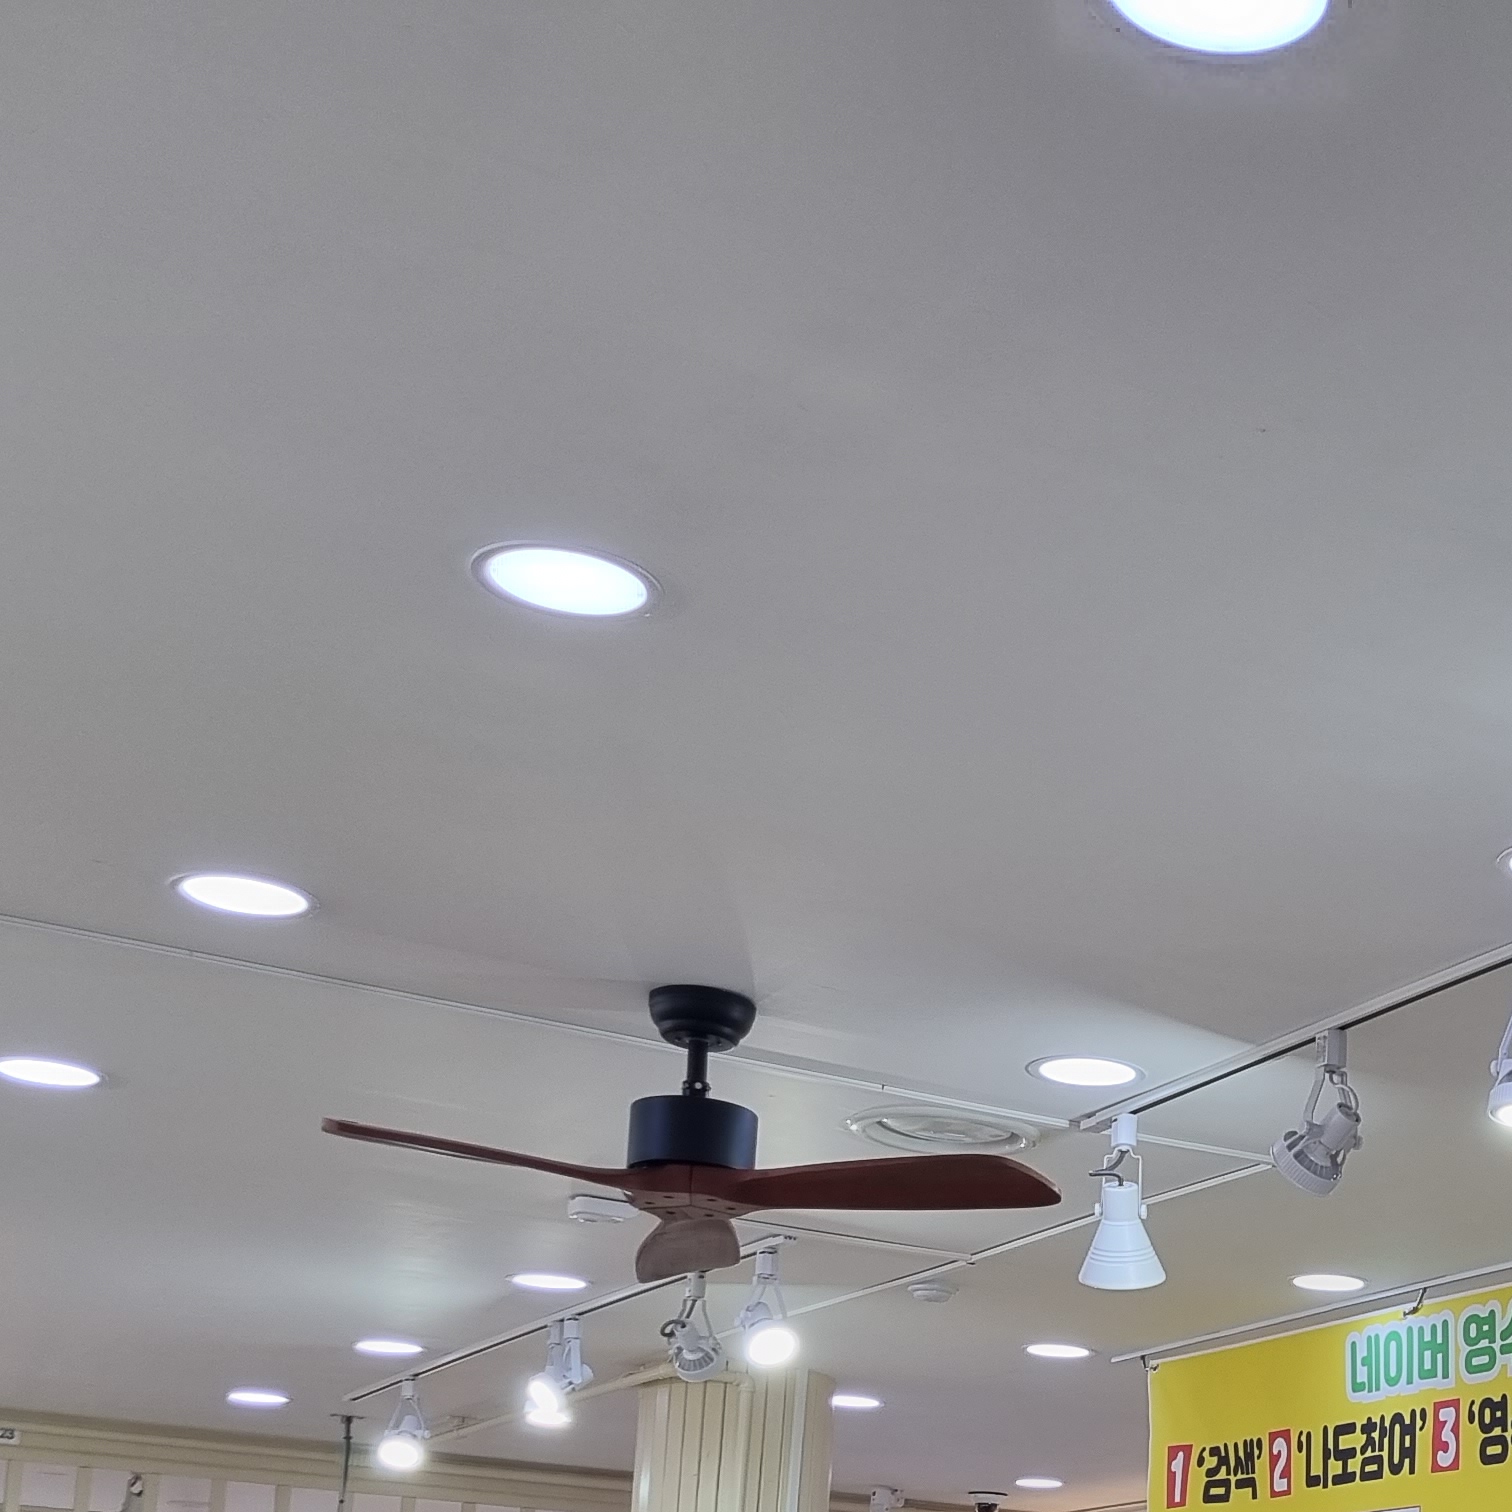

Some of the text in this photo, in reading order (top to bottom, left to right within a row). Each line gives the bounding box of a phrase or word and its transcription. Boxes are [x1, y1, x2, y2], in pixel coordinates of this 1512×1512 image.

[1349, 1318, 1452, 1395] 네이버
[1169, 1450, 1186, 1504] 1
[1271, 1436, 1289, 1495] 2
[1435, 1406, 1459, 1470] 3
